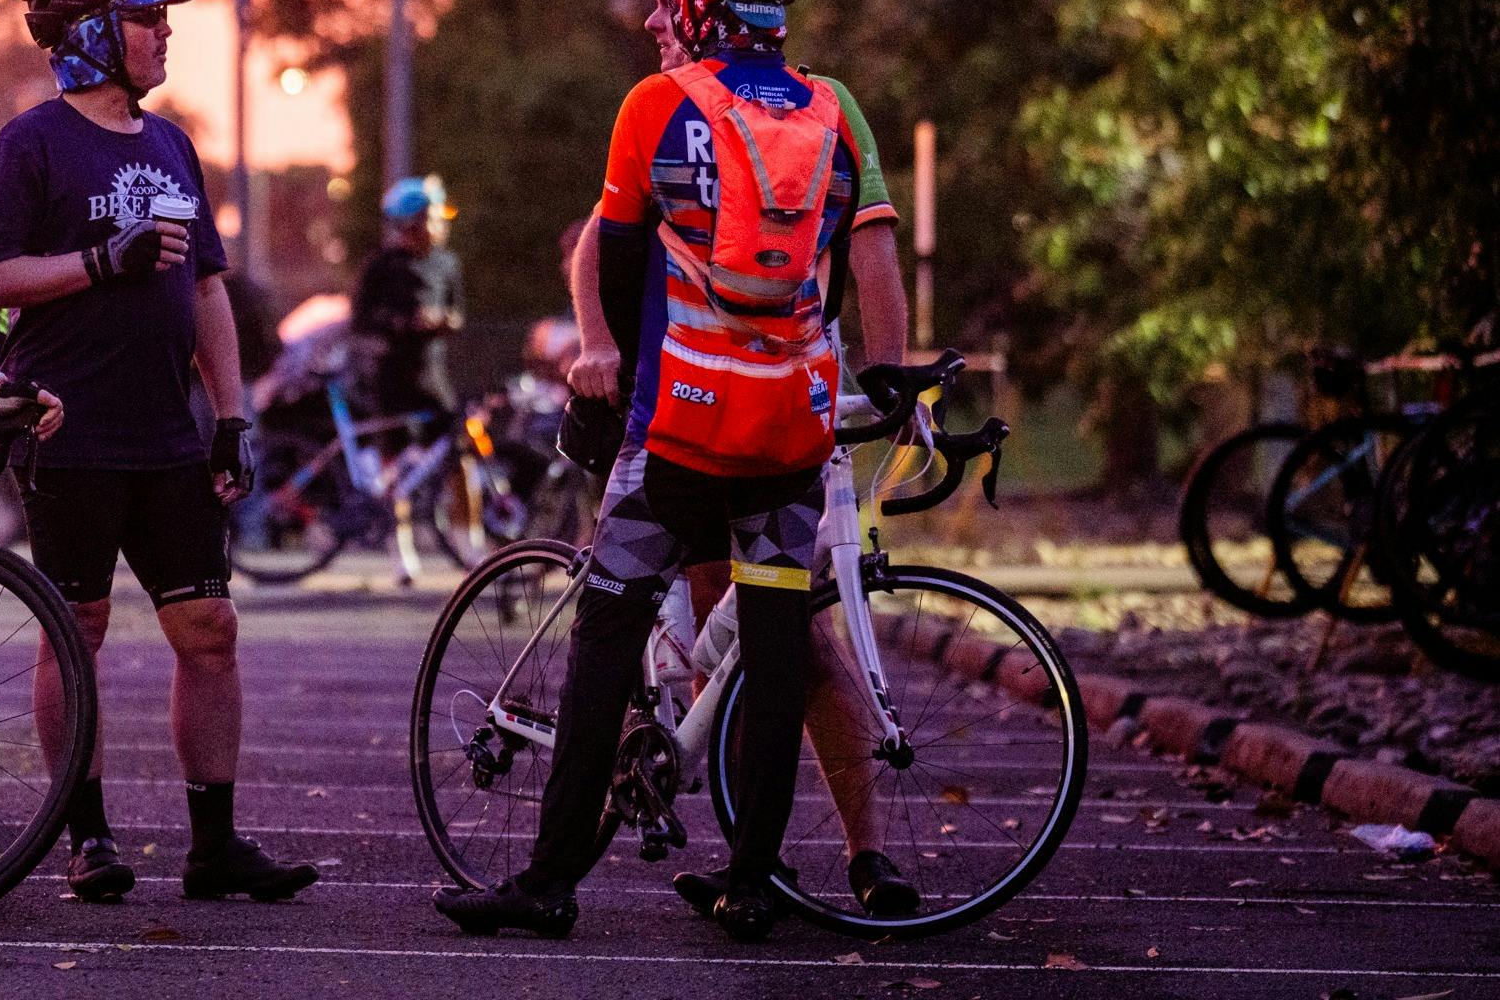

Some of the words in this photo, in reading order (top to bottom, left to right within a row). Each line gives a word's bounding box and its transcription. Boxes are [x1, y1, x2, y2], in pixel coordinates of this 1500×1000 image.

[138, 176, 146, 185] A
[131, 185, 159, 195] GOOD
[88, 194, 145, 221] BIKE
[671, 381, 715, 405] 2024
[809, 381, 829, 396] GREAT
